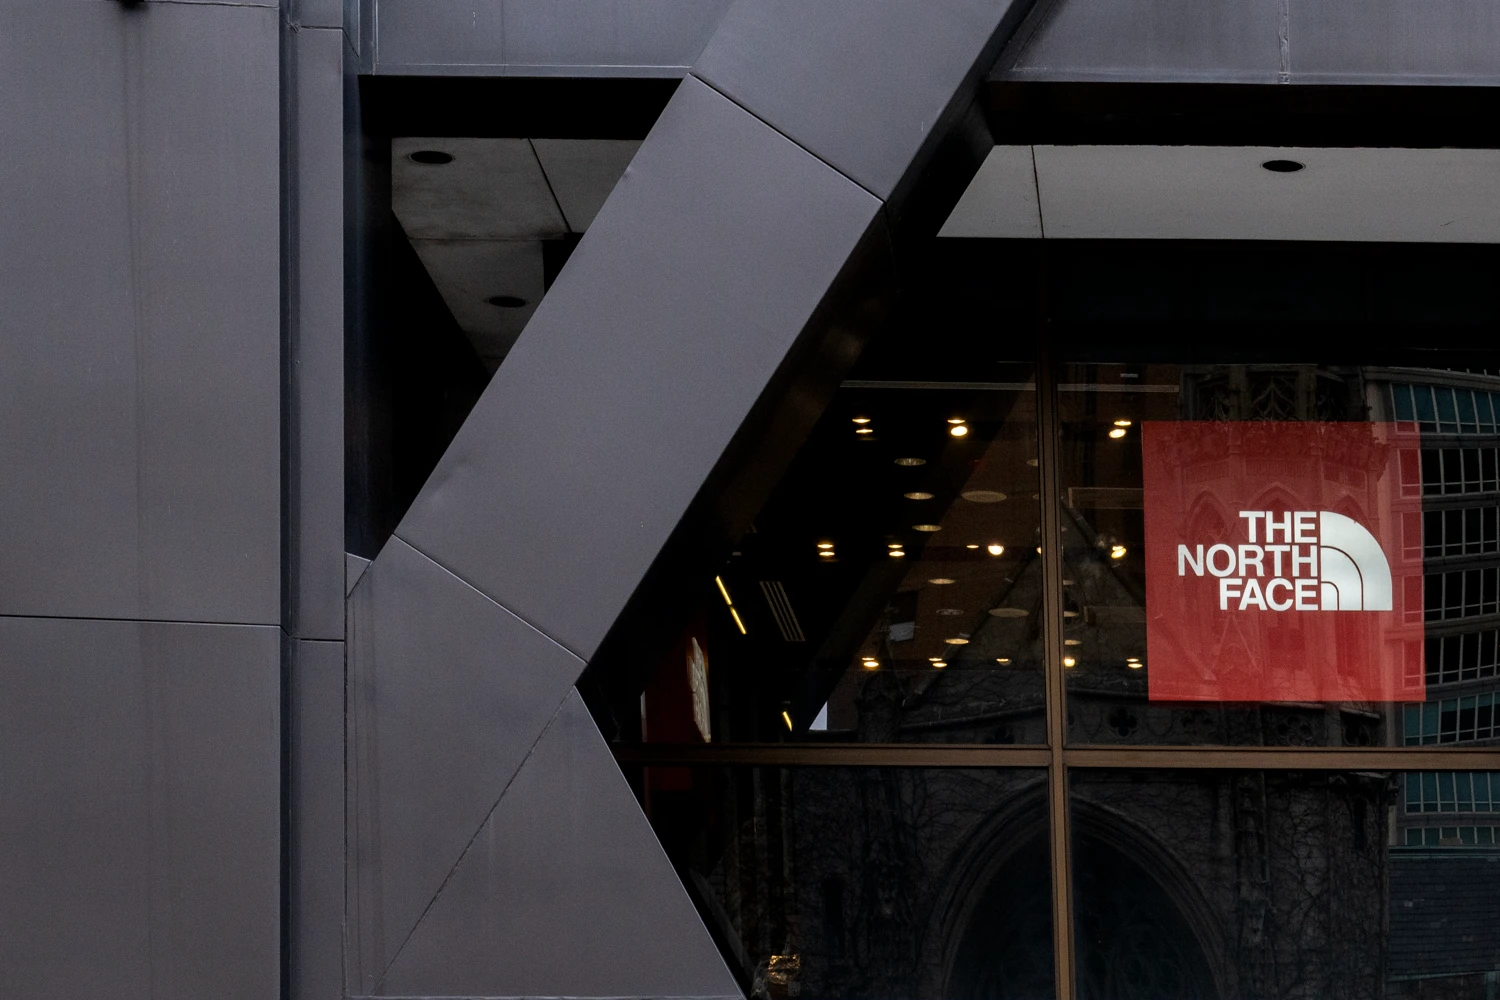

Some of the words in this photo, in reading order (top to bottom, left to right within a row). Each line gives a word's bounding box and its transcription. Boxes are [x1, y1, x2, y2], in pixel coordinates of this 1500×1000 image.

[1239, 511, 1317, 543] THE
[1178, 544, 1318, 577] NORTH
[1220, 578, 1318, 611] FACE
